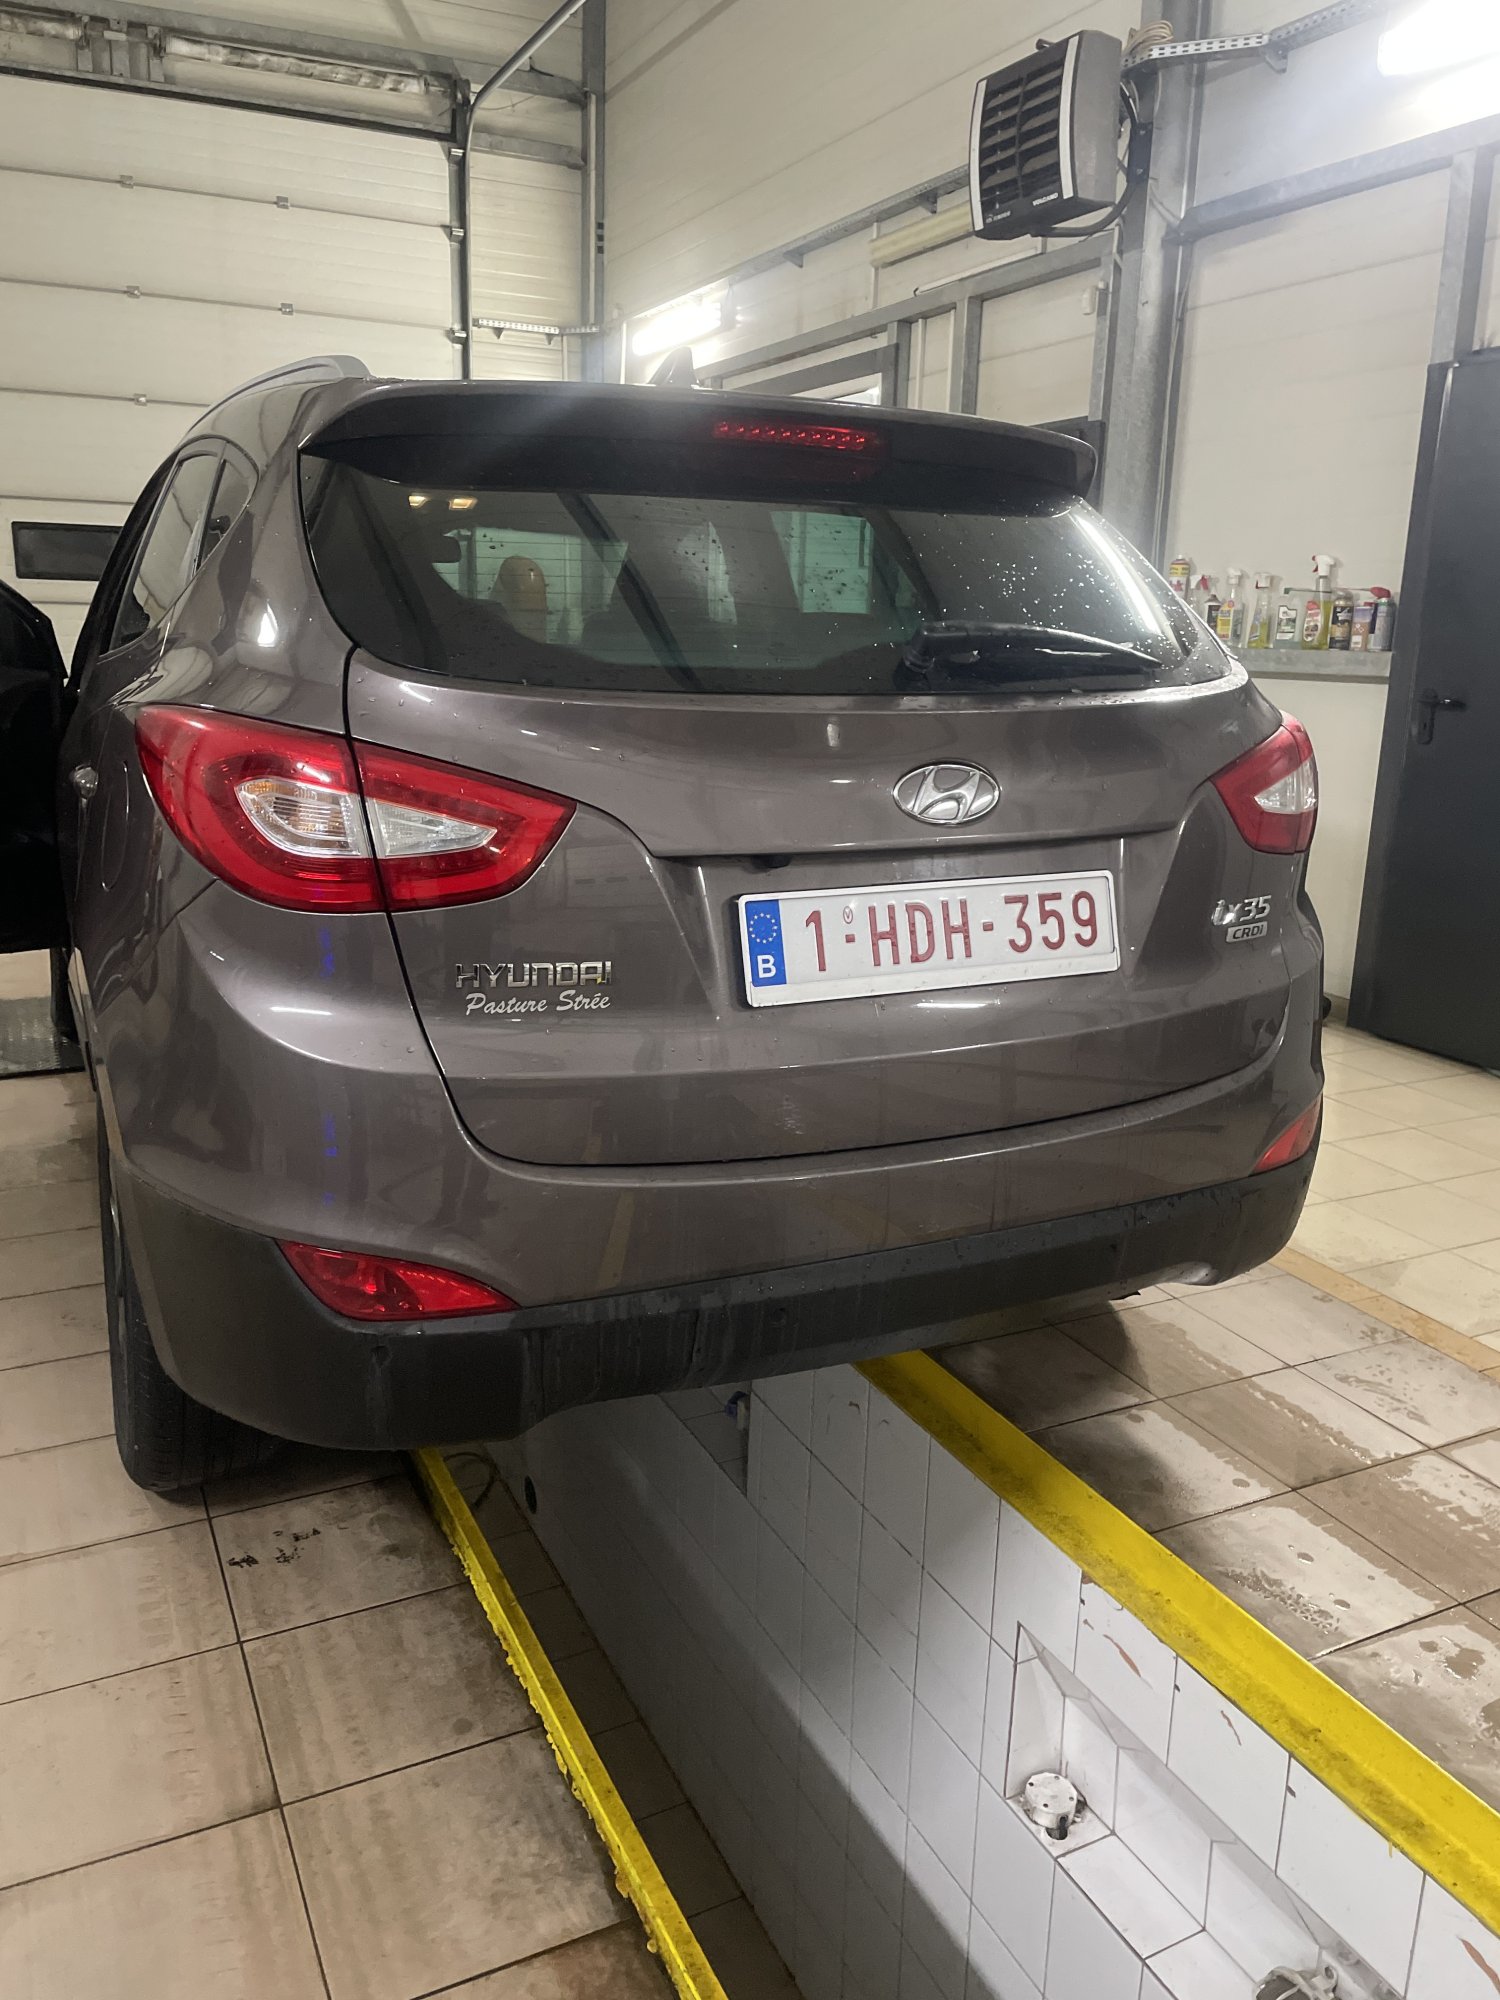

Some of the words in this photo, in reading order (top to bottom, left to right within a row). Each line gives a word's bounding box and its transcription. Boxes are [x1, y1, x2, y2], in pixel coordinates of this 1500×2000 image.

[805, 890, 1098, 972] 1-HDH-359
[455, 961, 612, 989] HYUNDAI
[757, 954, 777, 979] B
[465, 992, 548, 1016] Pasture
[556, 989, 611, 1012] Strée
